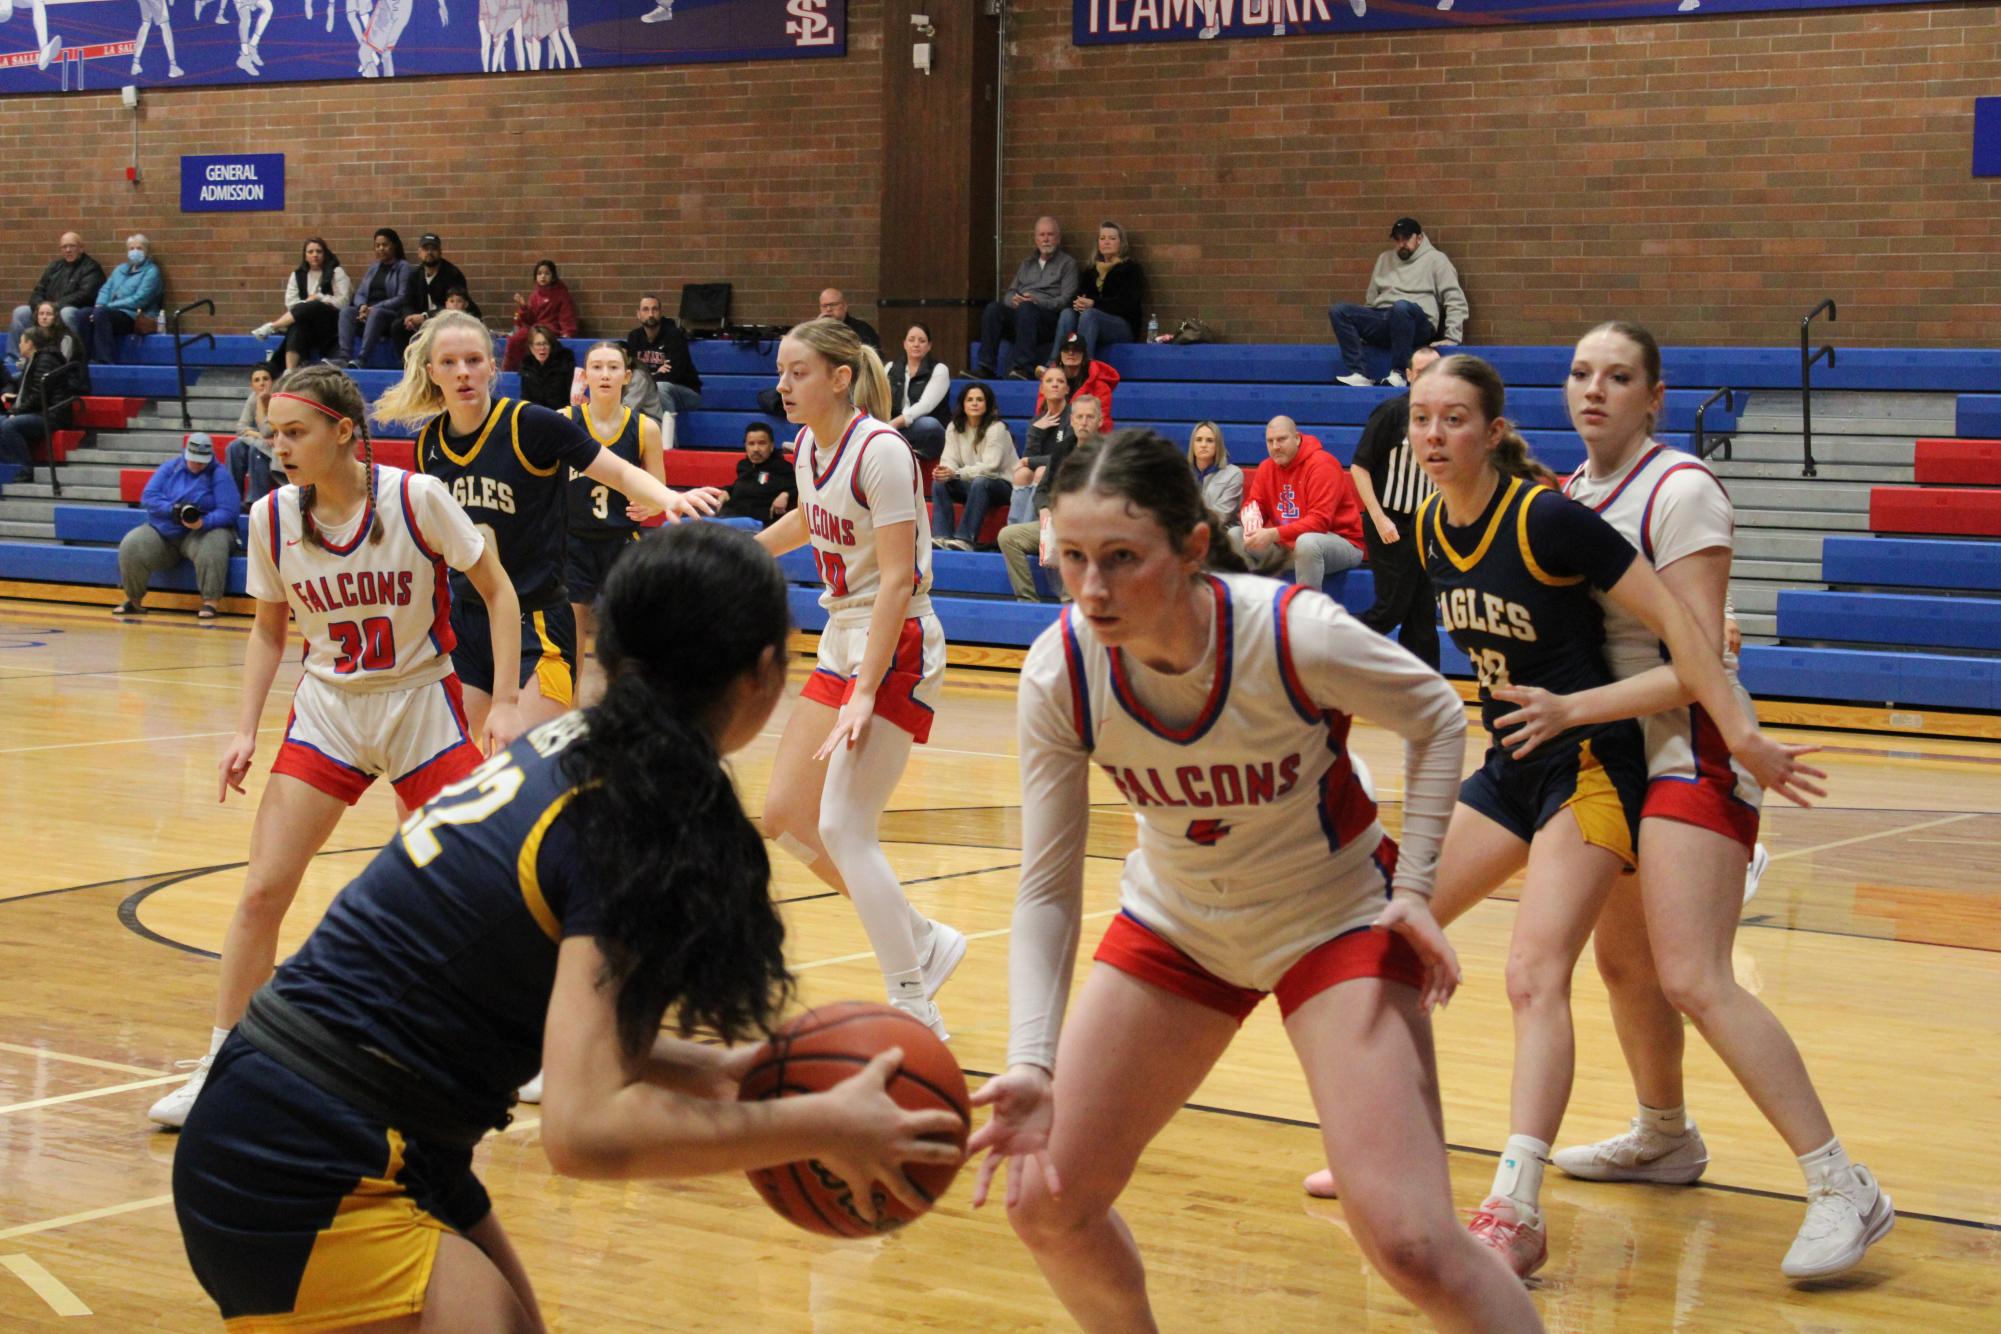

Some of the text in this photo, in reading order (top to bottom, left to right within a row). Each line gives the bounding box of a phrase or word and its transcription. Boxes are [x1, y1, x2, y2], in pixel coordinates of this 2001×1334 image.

[200, 184, 264, 201] ADMISSION
[205, 164, 258, 181] GENERAL
[444, 475, 516, 515] GLES
[591, 485, 609, 519] 3
[803, 502, 856, 546] LCONS
[291, 570, 413, 614] FALCONS
[1439, 588, 1538, 642] GLES
[328, 616, 396, 675] 30
[1102, 753, 1301, 807] FALCONS
